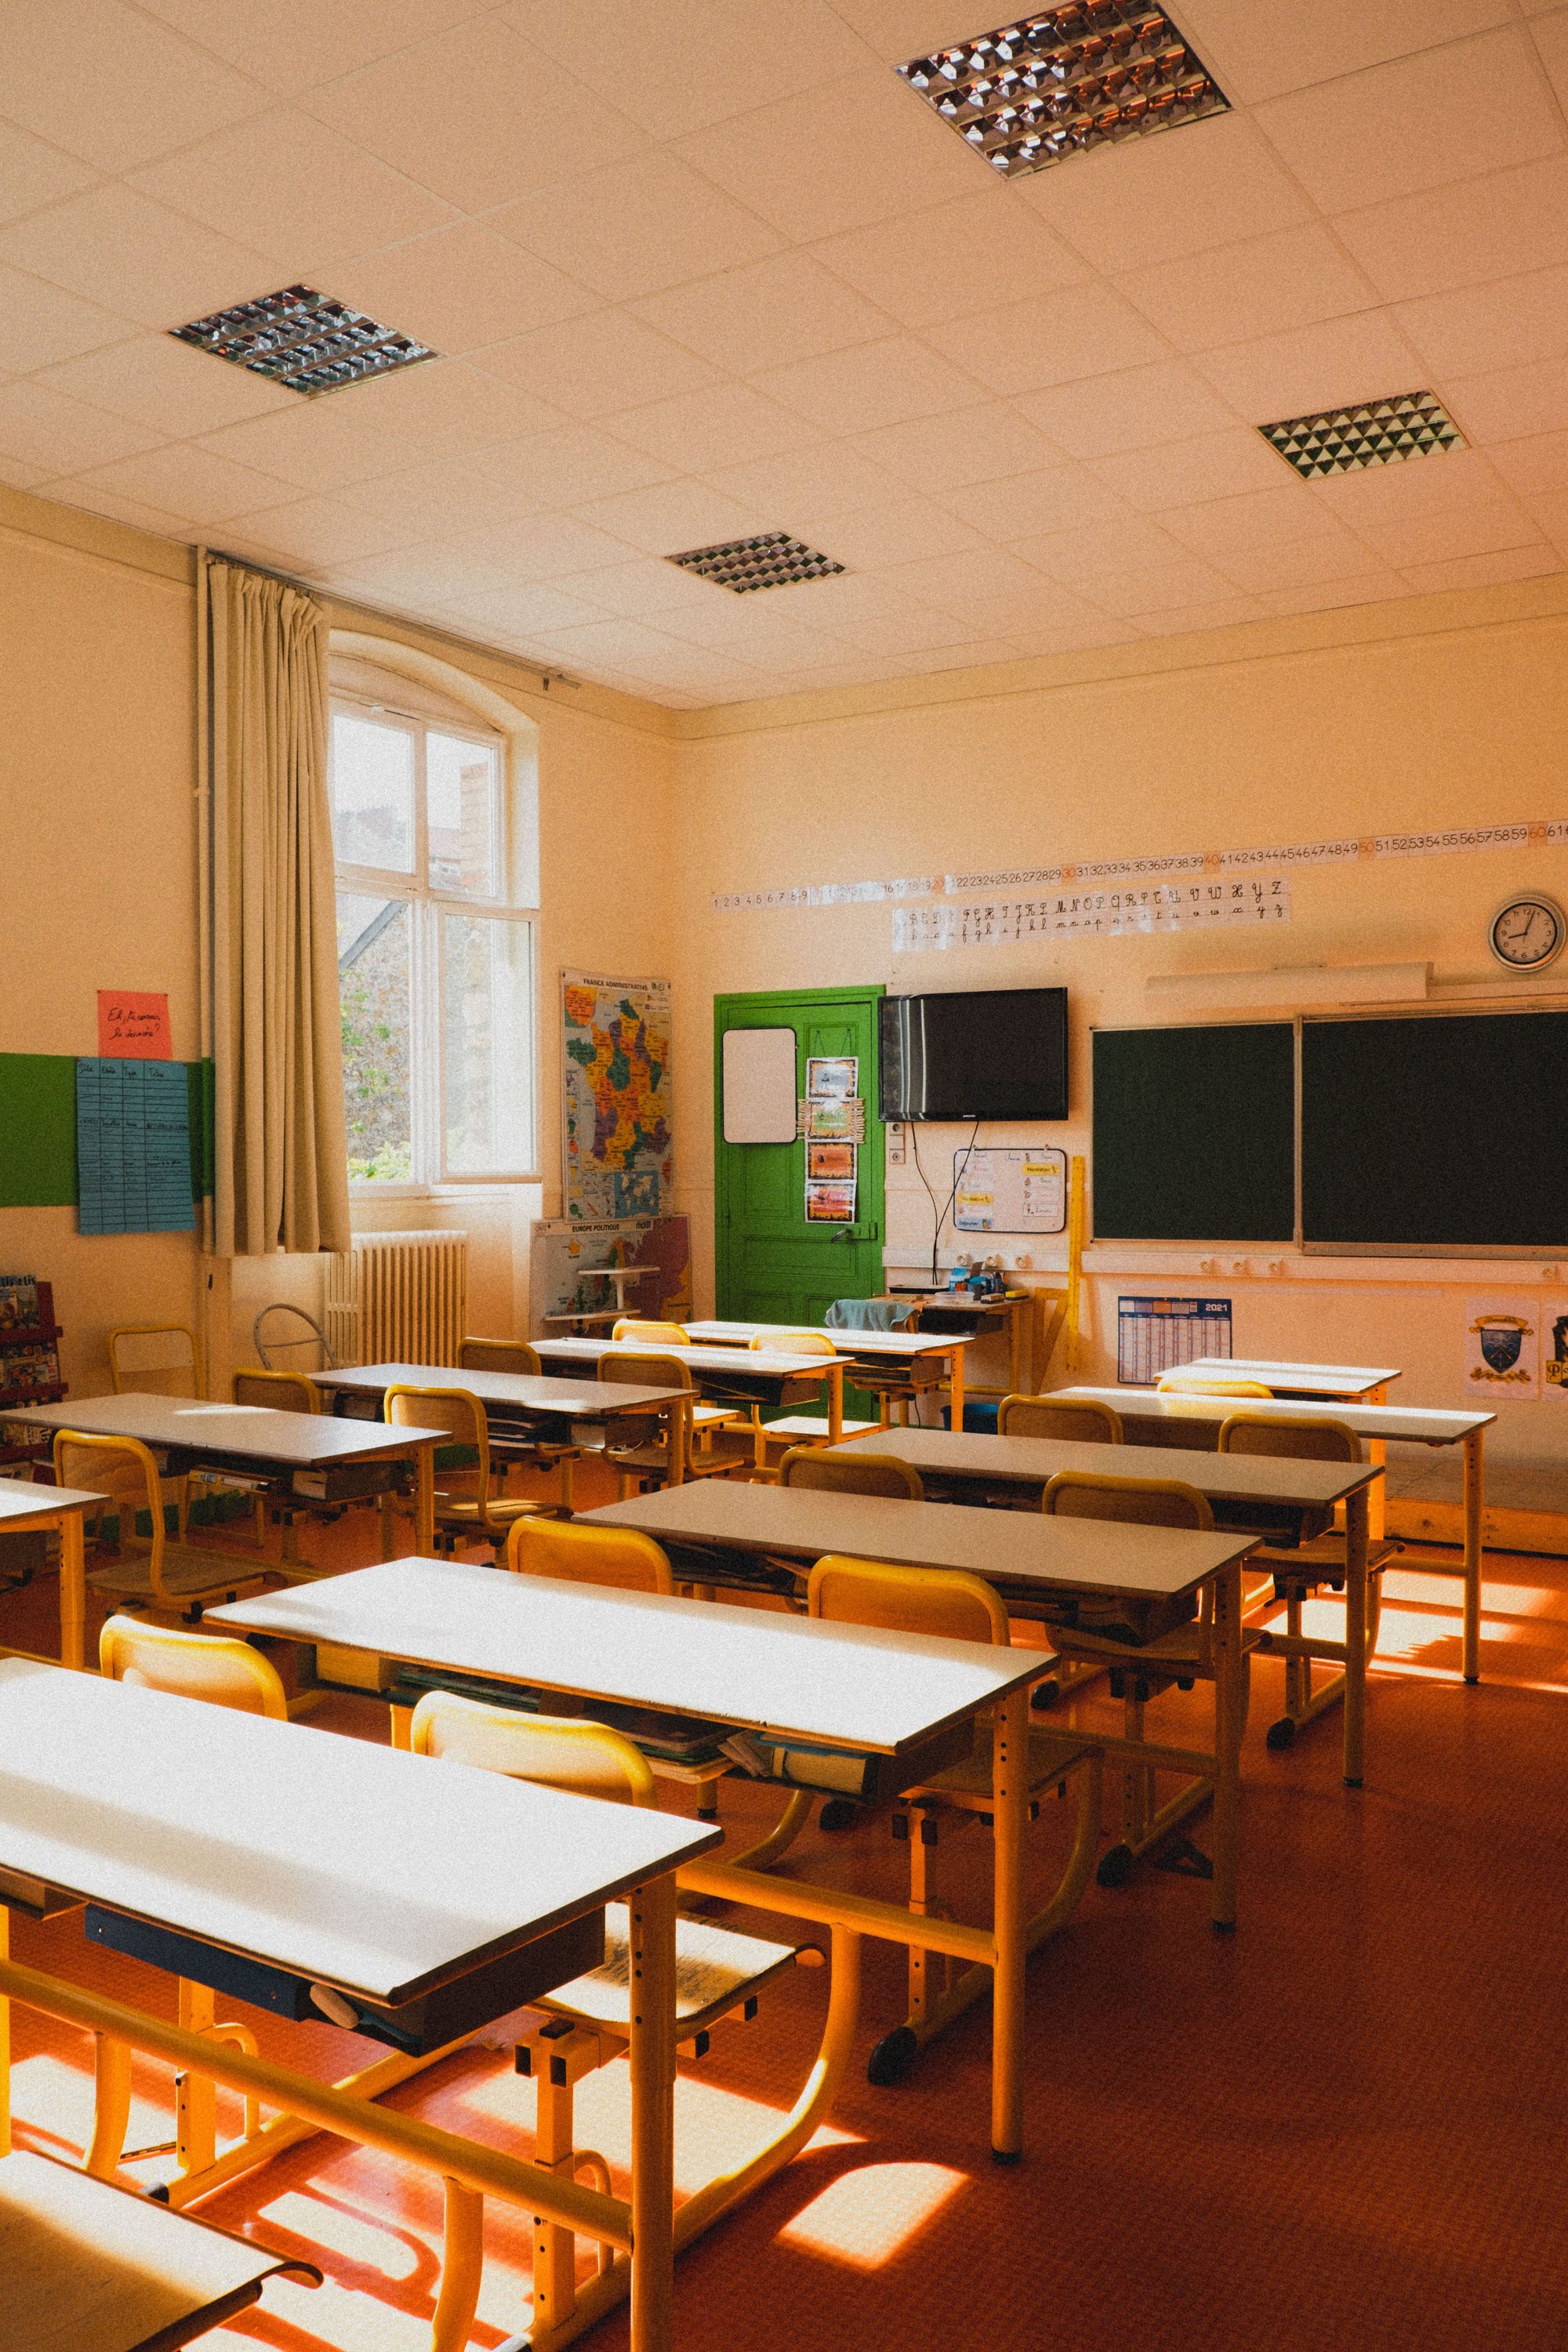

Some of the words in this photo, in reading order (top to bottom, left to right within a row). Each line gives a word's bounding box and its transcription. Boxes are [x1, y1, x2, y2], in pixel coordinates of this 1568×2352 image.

[713, 898, 719, 907] 1
[723, 897, 730, 908] 2
[734, 896, 741, 906] 3
[746, 895, 753, 905] 4
[756, 894, 763, 904] 5
[767, 893, 774, 903] 6
[779, 891, 786, 902] 7
[790, 891, 797, 902] 8
[801, 890, 808, 900] 9
[883, 883, 894, 894] 16
[932, 878, 945, 891] 20
[956, 877, 969, 887] 22
[969, 876, 982, 887] 23
[982, 875, 996, 886] 24
[995, 873, 1008, 885] 25
[1008, 873, 1022, 884] 26
[1022, 871, 1036, 883] 27
[1036, 870, 1049, 881] 28
[1048, 869, 1062, 880] 29
[1062, 867, 1076, 878] 30
[1076, 866, 1089, 877] 31
[1090, 865, 1104, 876] 32
[1105, 863, 1118, 874] 33
[1118, 862, 1131, 873] 34
[1132, 861, 1147, 872] 35
[1147, 859, 1161, 871] 36
[1160, 858, 1174, 870] 37
[1174, 857, 1189, 869] 38
[1190, 856, 1204, 867] 39
[1205, 854, 1220, 866] 40
[1219, 854, 1232, 865] 41
[1234, 852, 1248, 864] 42
[1250, 851, 1264, 862] 43
[1265, 849, 1279, 860] 44
[1279, 848, 1295, 859] 45
[1295, 847, 1311, 858] 46
[1311, 845, 1326, 855] 47
[1327, 844, 1342, 855] 48
[1343, 843, 1358, 854] 49
[1359, 841, 1375, 853] 50
[1375, 840, 1388, 851] 51
[1392, 838, 1407, 850] 52
[1409, 837, 1425, 849] 53
[1425, 836, 1440, 848] 54
[1442, 833, 1458, 846] 55
[1460, 833, 1475, 844] 56
[1476, 830, 1493, 844] 57
[1494, 829, 1511, 842] 58
[1512, 828, 1527, 840] 59
[1529, 826, 1547, 839] 60
[1547, 825, 1563, 837] 61
[963, 909, 971, 922] F
[973, 908, 981, 928] G
[1015, 904, 1022, 924] J
[1025, 903, 1036, 916] K
[1054, 900, 1066, 914] M
[1069, 898, 1080, 912] N
[1083, 897, 1092, 911] O
[1125, 893, 1137, 907] R
[1152, 891, 1161, 904] T
[1189, 887, 1200, 902] V
[1207, 886, 1222, 900] W
[1232, 884, 1243, 898] X
[1251, 883, 1263, 904] Y
[1272, 880, 1282, 895] Z
[583, 978, 604, 987] FRANCE
[605, 981, 648, 992] ADMINISTRATIVE
[1205, 1303, 1228, 1312] 2021
